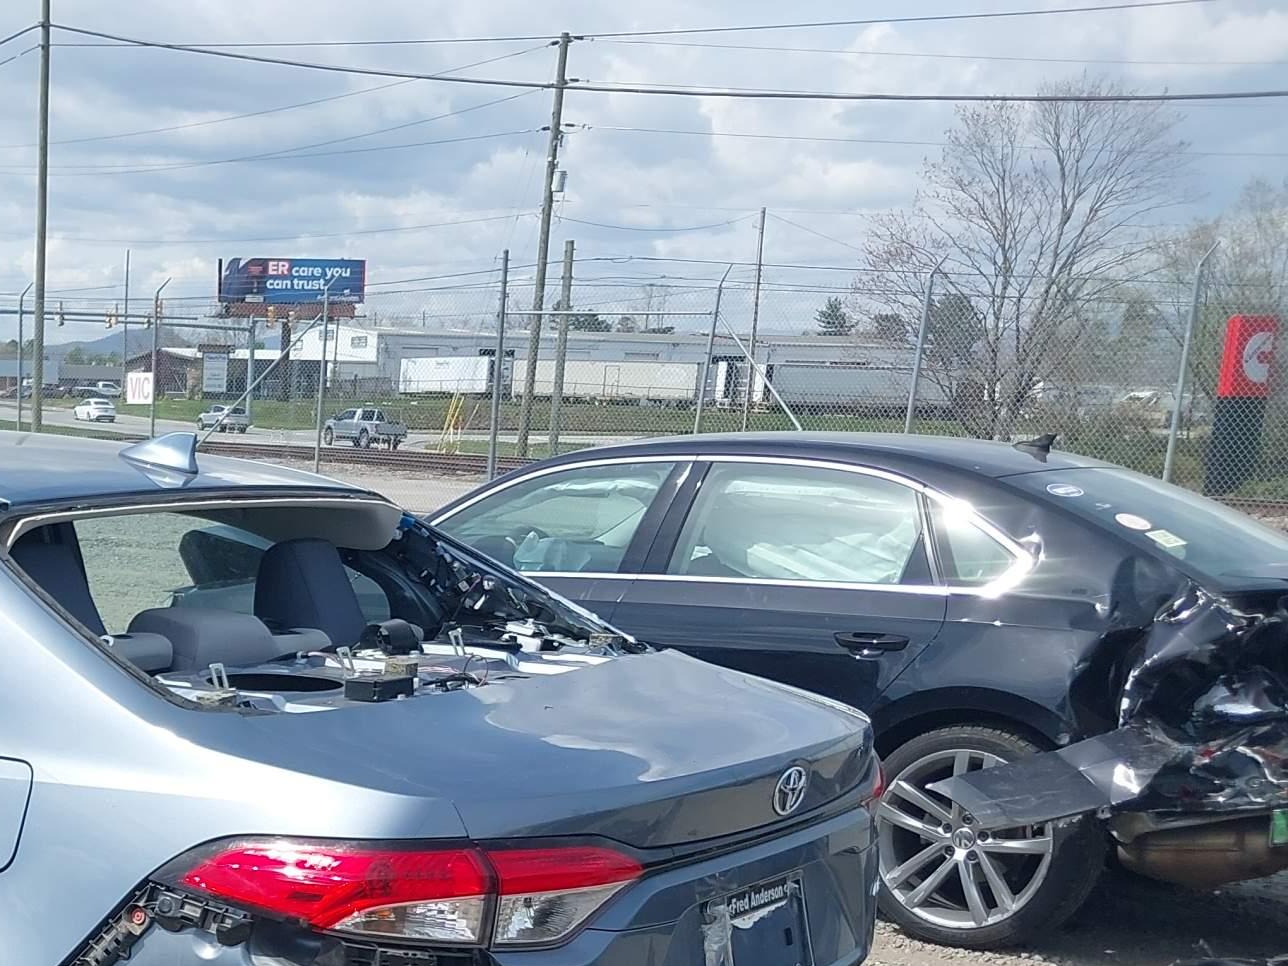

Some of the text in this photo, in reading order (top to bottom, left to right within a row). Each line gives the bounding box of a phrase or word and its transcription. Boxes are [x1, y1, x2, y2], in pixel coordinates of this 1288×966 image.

[268, 261, 289, 275] ER
[292, 266, 322, 277] care
[325, 266, 351, 279] you
[266, 279, 291, 289] can
[731, 885, 784, 914] Fred Anderson
